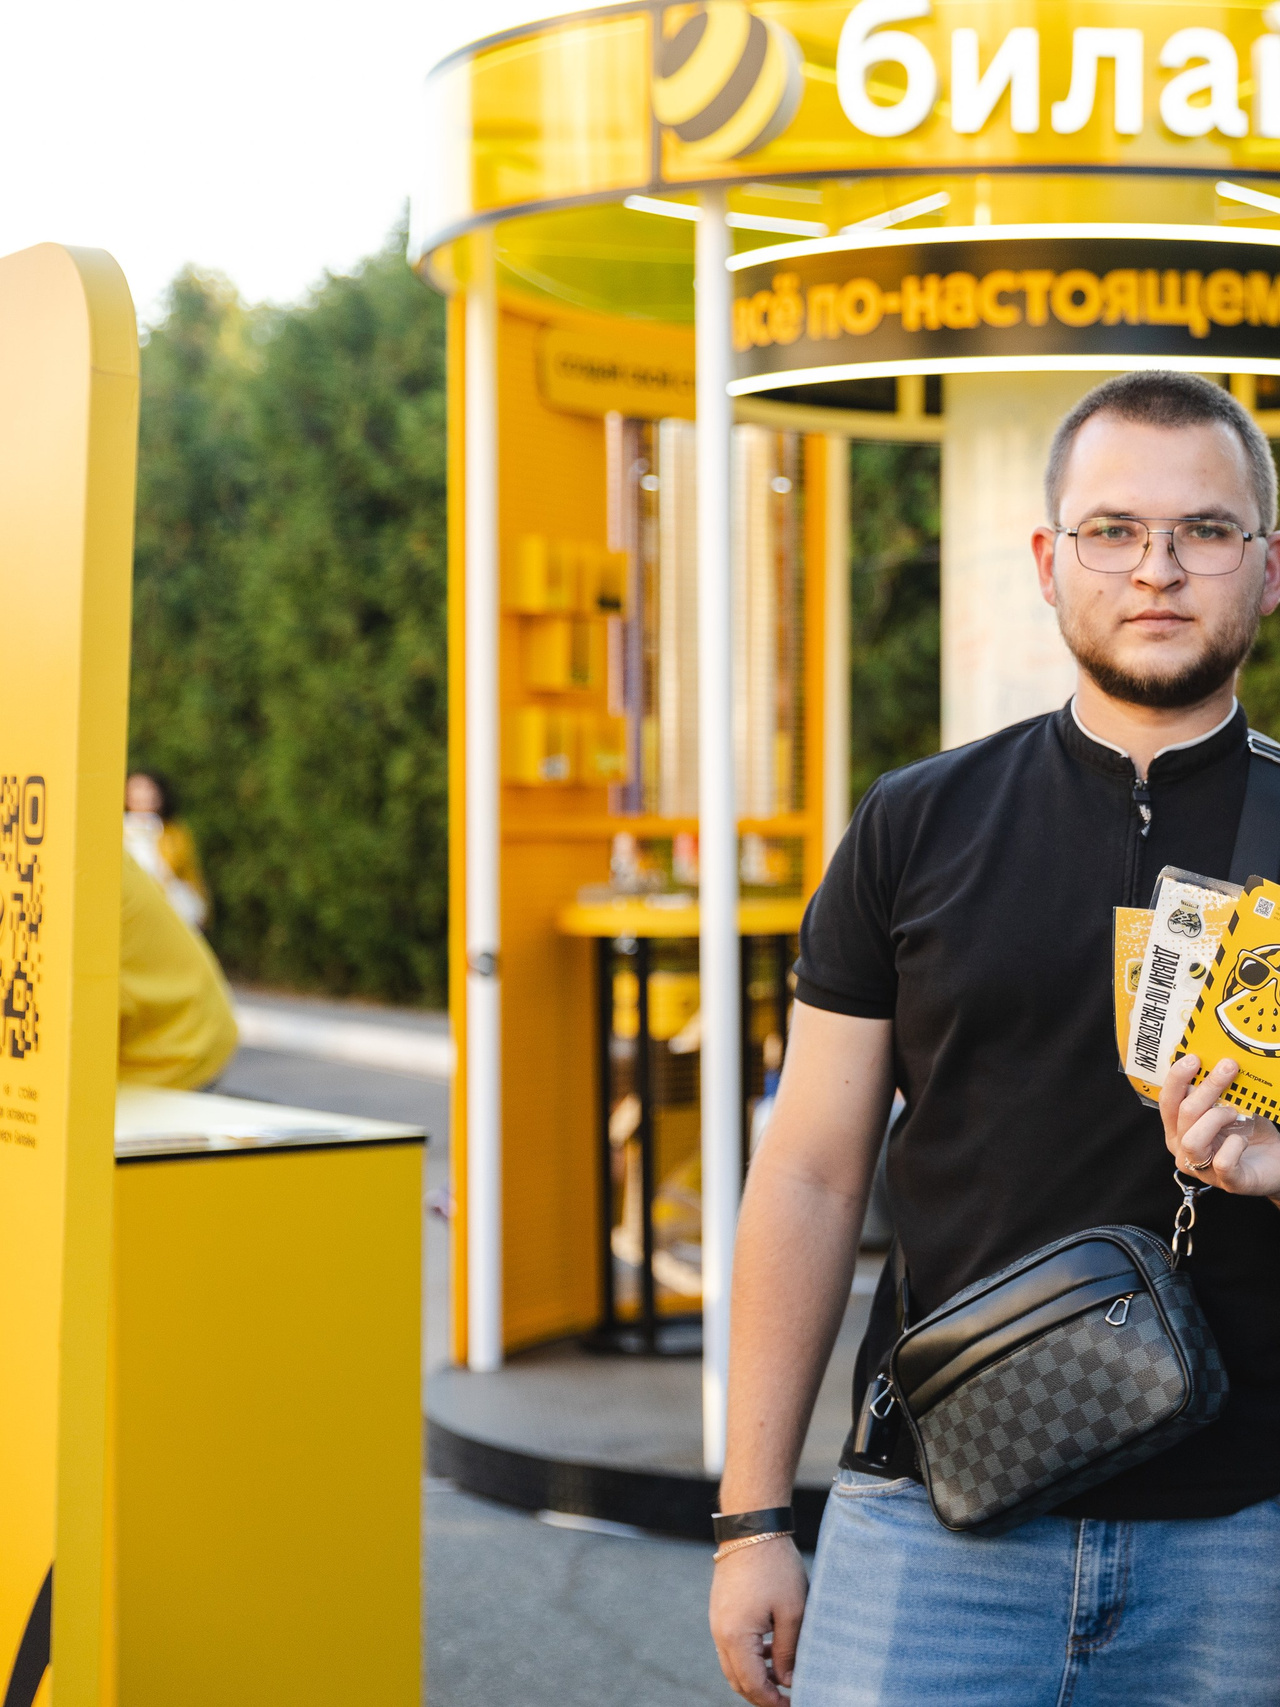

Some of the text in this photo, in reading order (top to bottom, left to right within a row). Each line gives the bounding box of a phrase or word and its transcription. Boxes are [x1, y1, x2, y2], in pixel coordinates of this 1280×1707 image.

[1134, 944, 1181, 1074] ДАВАЙ ПО-НАСТОЯЩЕМУ
[1246, 1072, 1273, 1087] Астрахань
